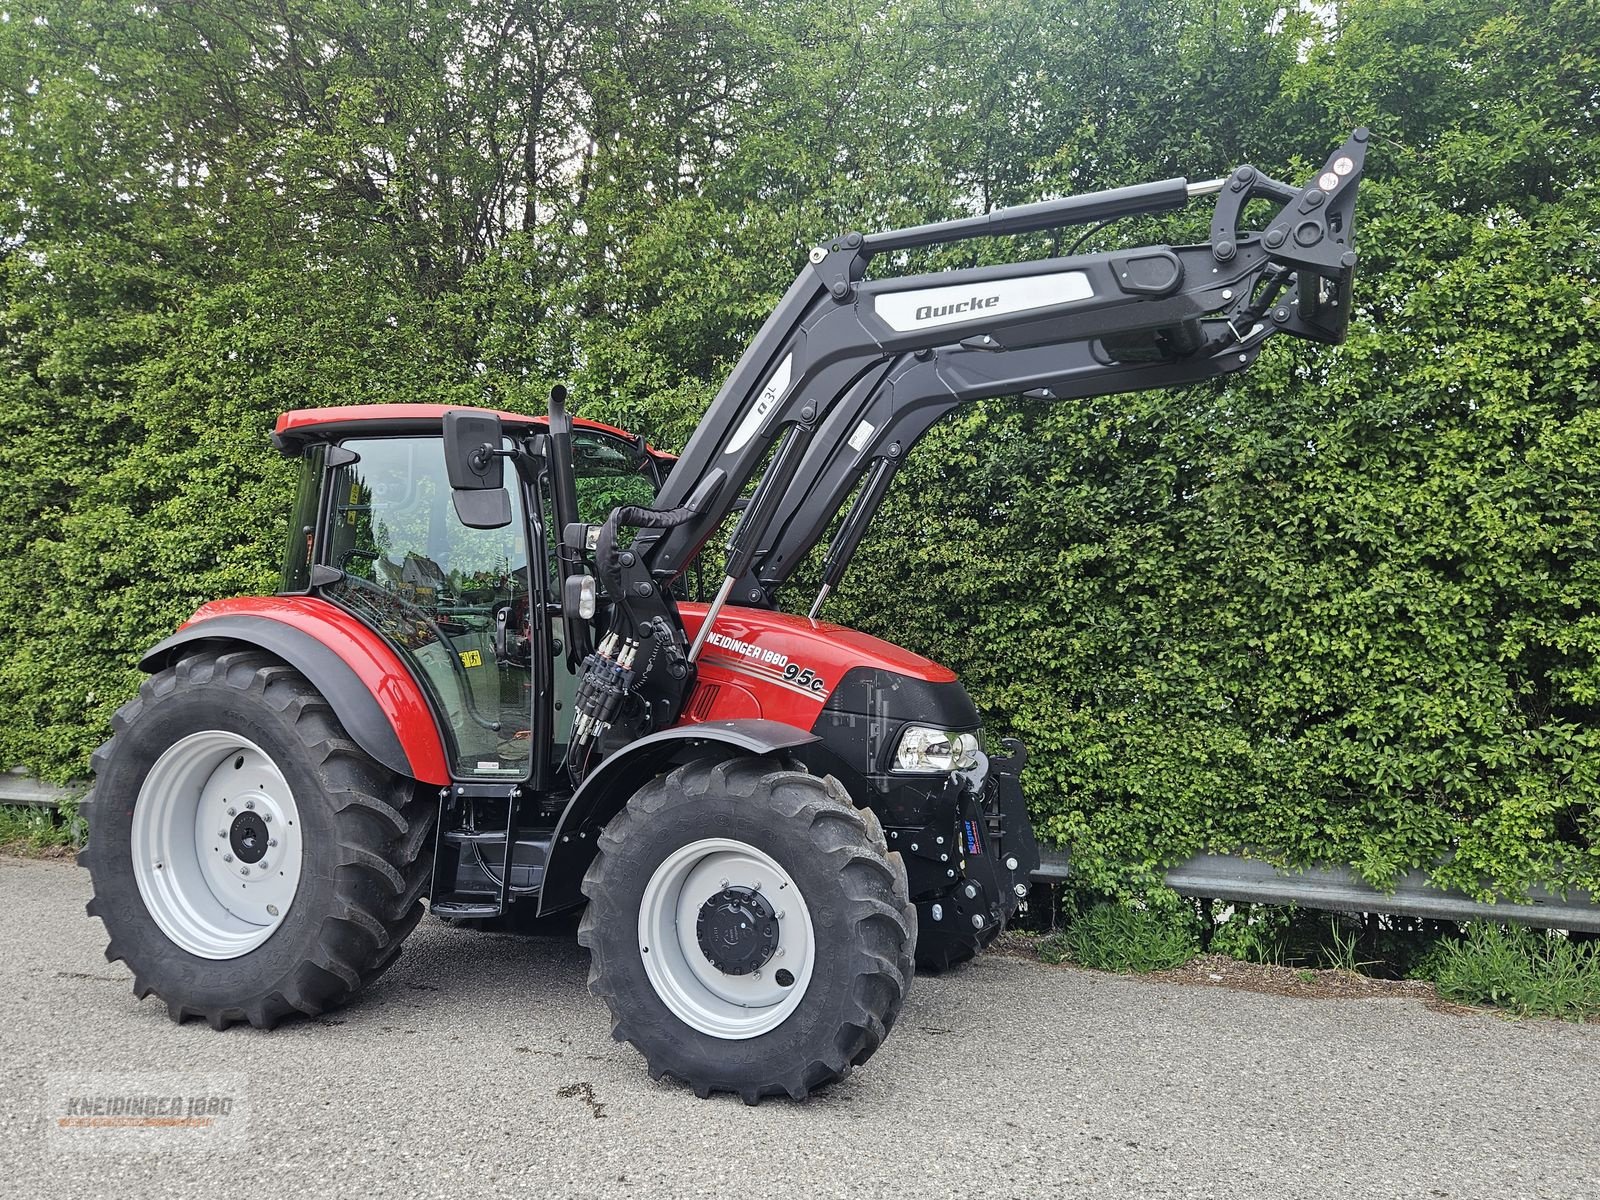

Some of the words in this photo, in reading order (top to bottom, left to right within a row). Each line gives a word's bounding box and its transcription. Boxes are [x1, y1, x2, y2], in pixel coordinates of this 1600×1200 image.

[915, 295, 999, 321] Quicke
[705, 631, 762, 659] NEIDINGER
[761, 649, 788, 667] 1880
